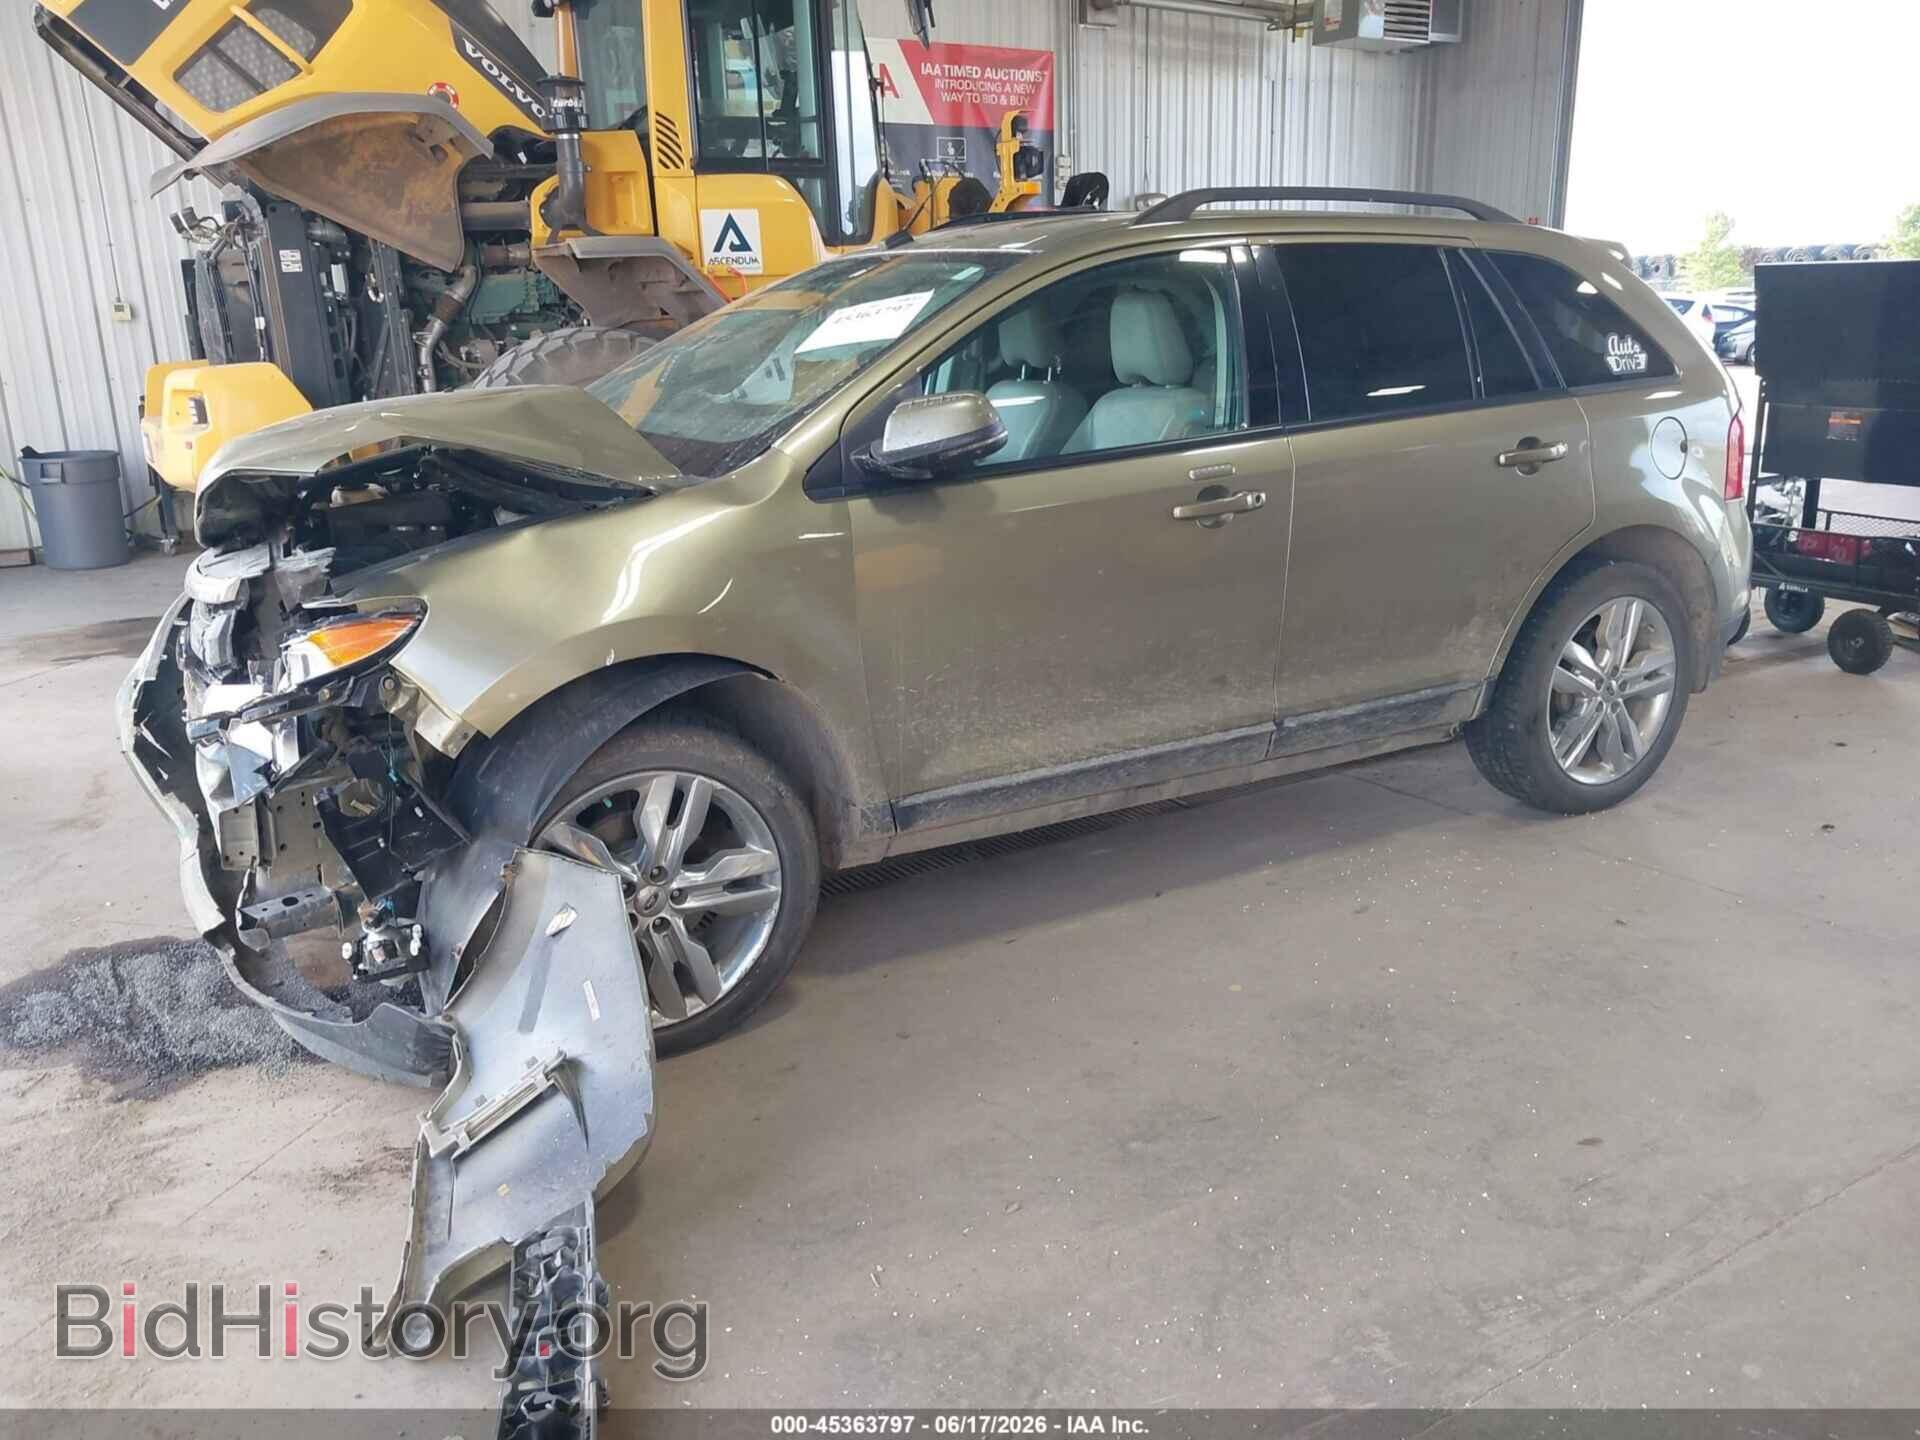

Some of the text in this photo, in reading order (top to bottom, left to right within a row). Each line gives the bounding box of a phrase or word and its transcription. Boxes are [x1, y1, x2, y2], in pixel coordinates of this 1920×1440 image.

[462, 36, 546, 118] VOLVO
[921, 62, 1043, 83] IAA TIMED AUCTIONS
[934, 78, 1036, 95] INTRODUCING A NEW
[941, 91, 1030, 107] WAY TO BID & BUY
[709, 256, 760, 265] ASCENDUM
